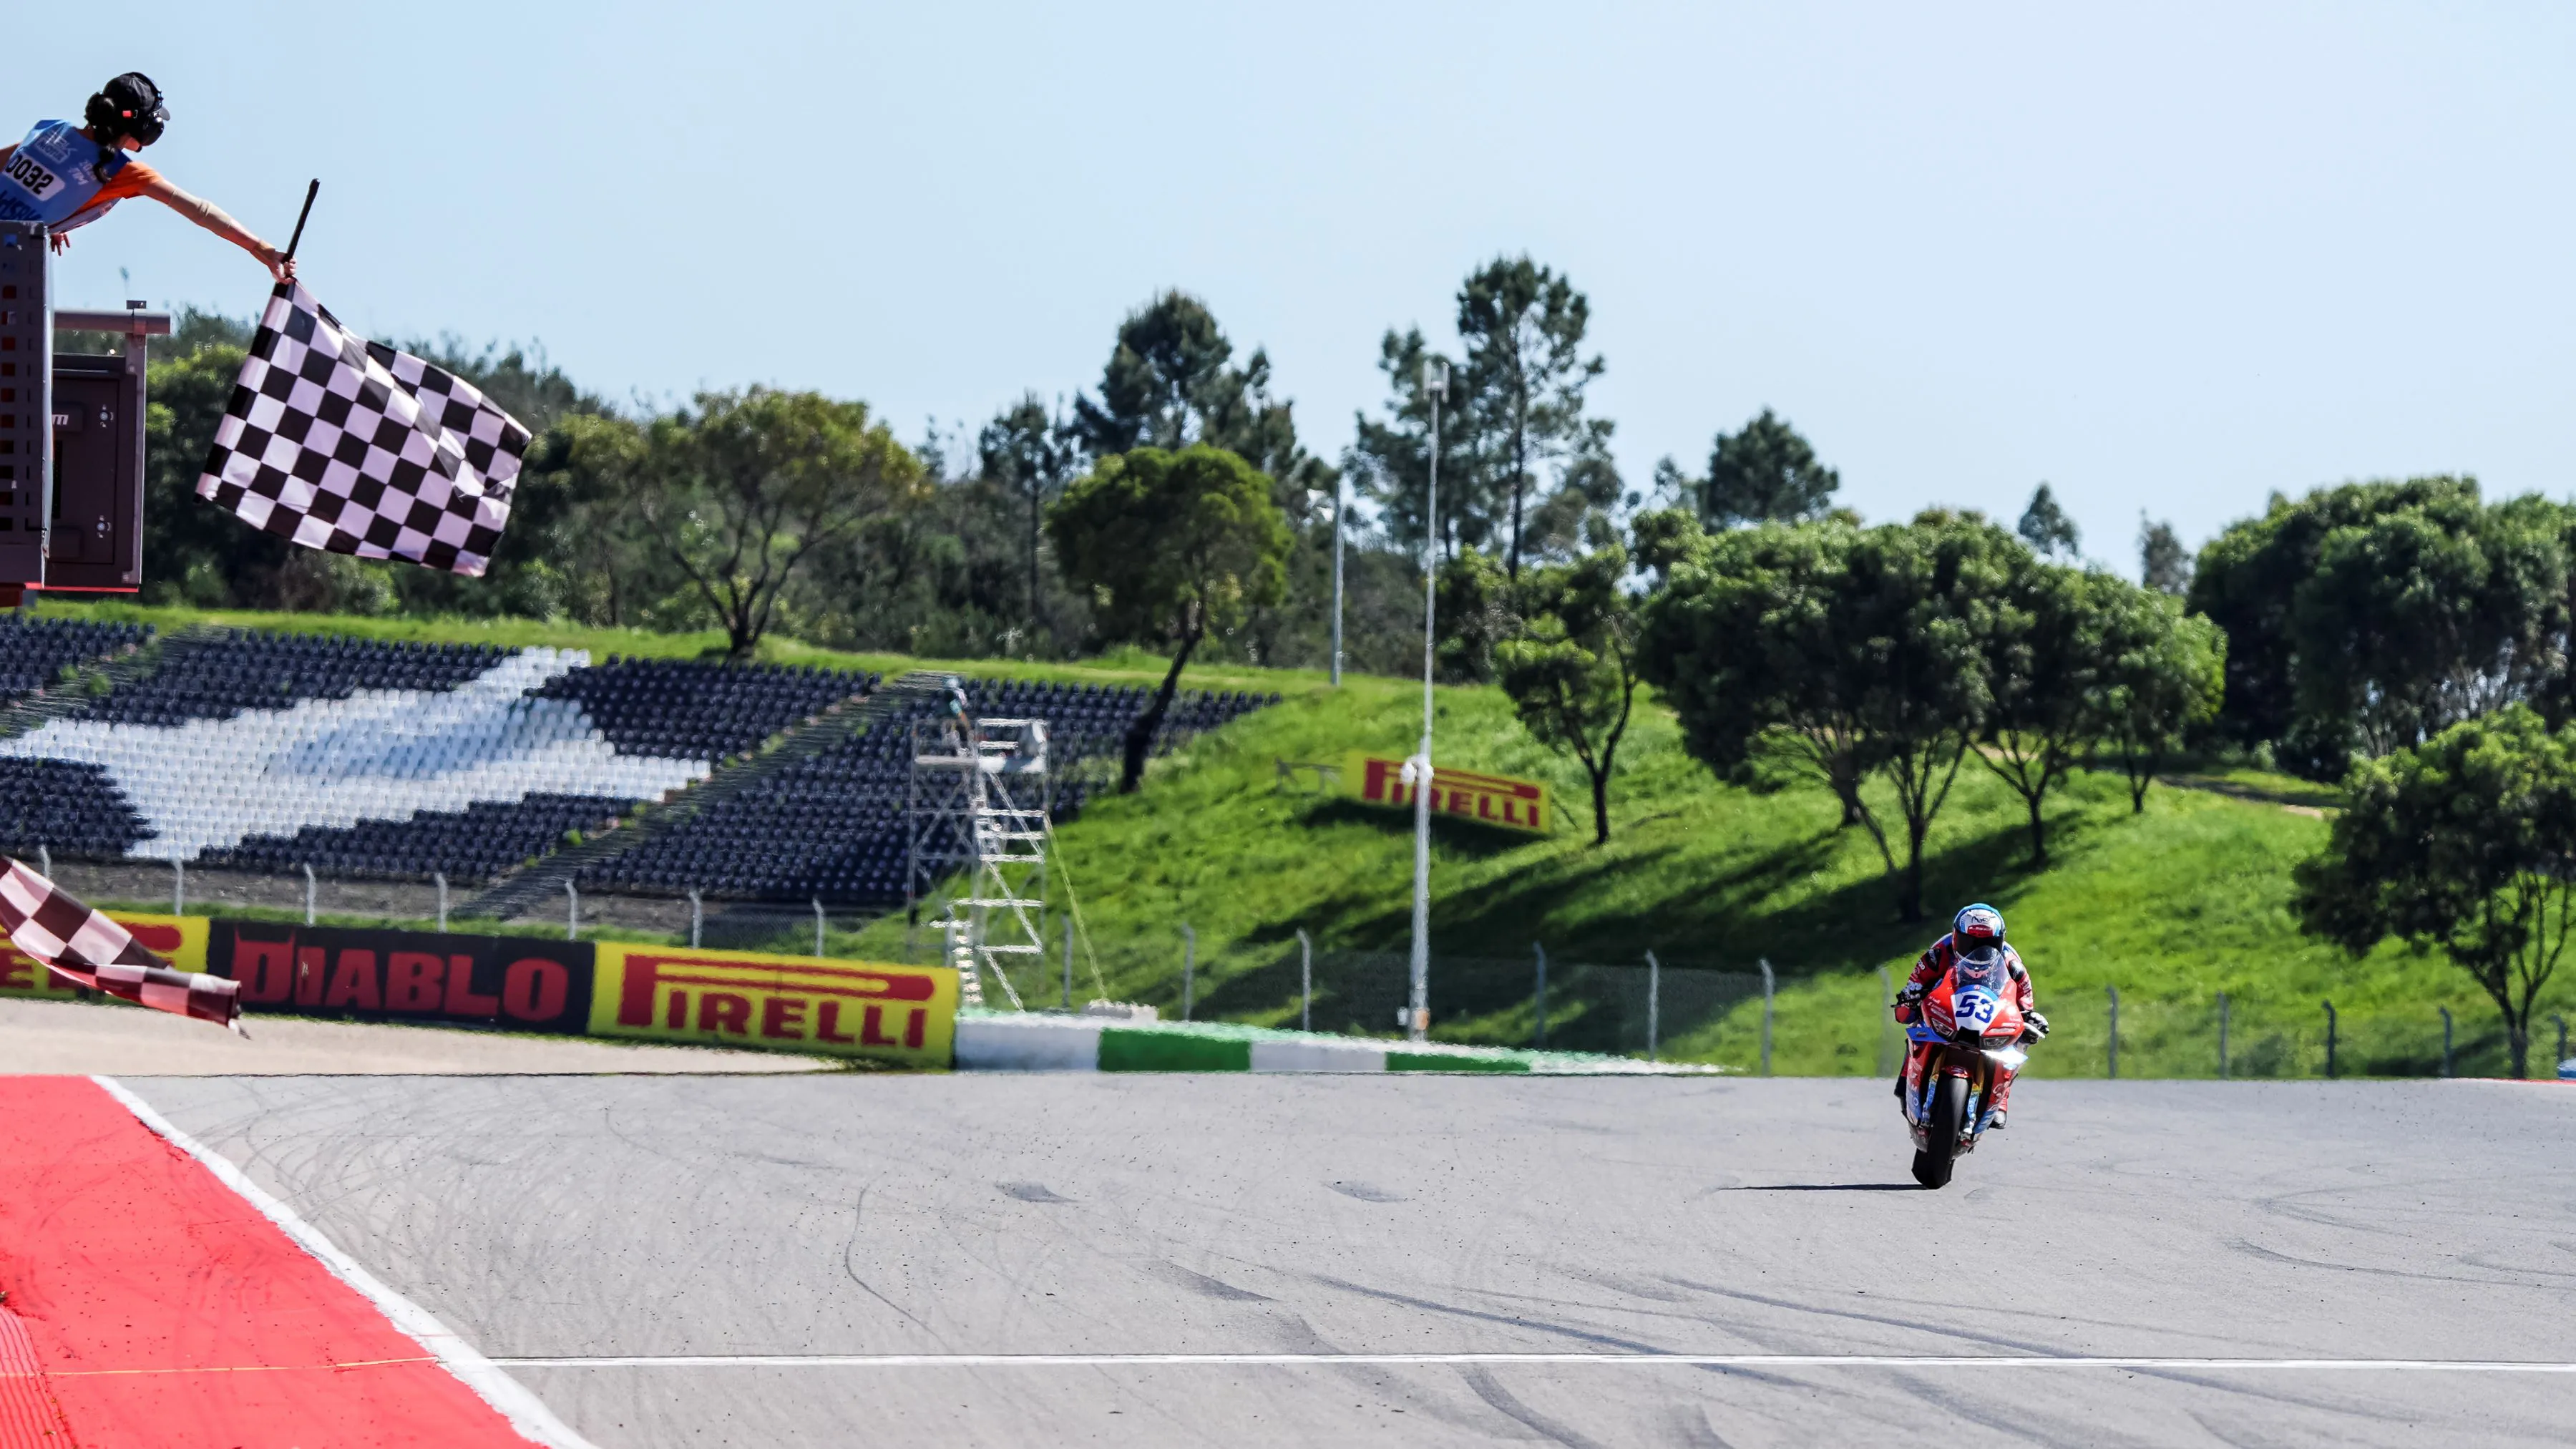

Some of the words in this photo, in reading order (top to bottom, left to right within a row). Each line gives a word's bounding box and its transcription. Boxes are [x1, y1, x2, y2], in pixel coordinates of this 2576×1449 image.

[1363, 757, 1541, 827] PIRELLI
[233, 925, 568, 1022] DIABLO
[617, 953, 935, 1050] PIRELLI
[1955, 994, 1994, 1024] 53
